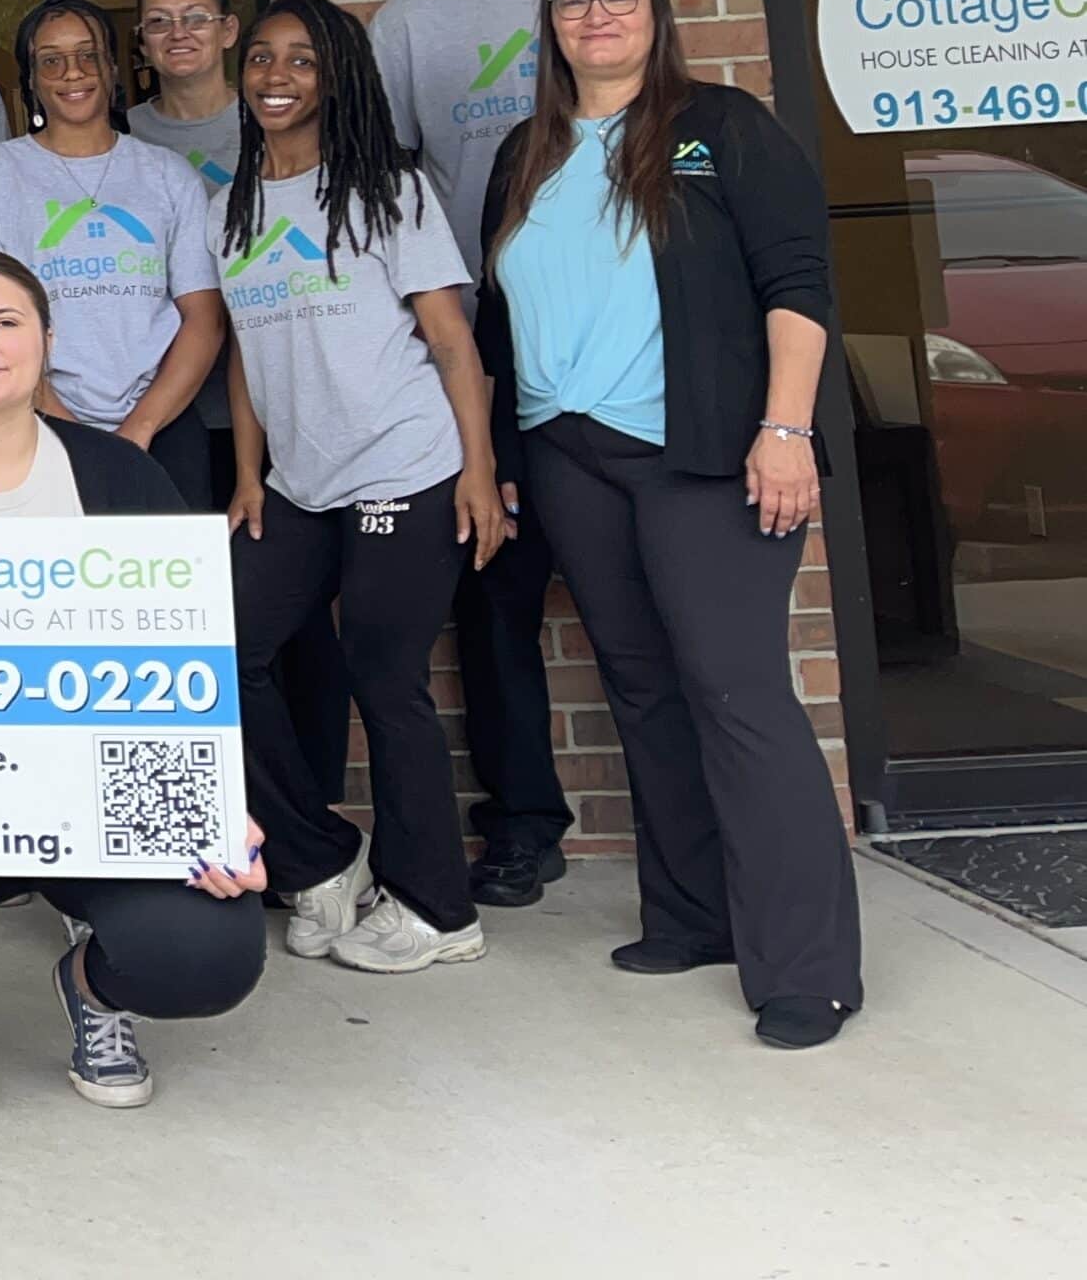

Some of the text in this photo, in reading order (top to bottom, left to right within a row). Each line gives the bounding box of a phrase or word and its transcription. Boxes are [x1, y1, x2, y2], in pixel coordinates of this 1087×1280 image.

[861, 48, 938, 70] HOUSE
[945, 41, 1060, 65] CLEANING
[452, 95, 533, 124] Cottag
[30, 250, 164, 281] ottageCar
[62, 284, 120, 298] CLEANING
[123, 285, 136, 297] AT
[140, 285, 152, 297] ITS
[226, 271, 352, 309] ottageCare
[247, 310, 293, 329] CLEANING
[297, 308, 308, 320] AT
[327, 303, 357, 316] BEST!
[361, 515, 394, 534] 93
[47, 608, 75, 631] AT
[89, 609, 124, 631] ITS
[137, 609, 207, 631] BEST!
